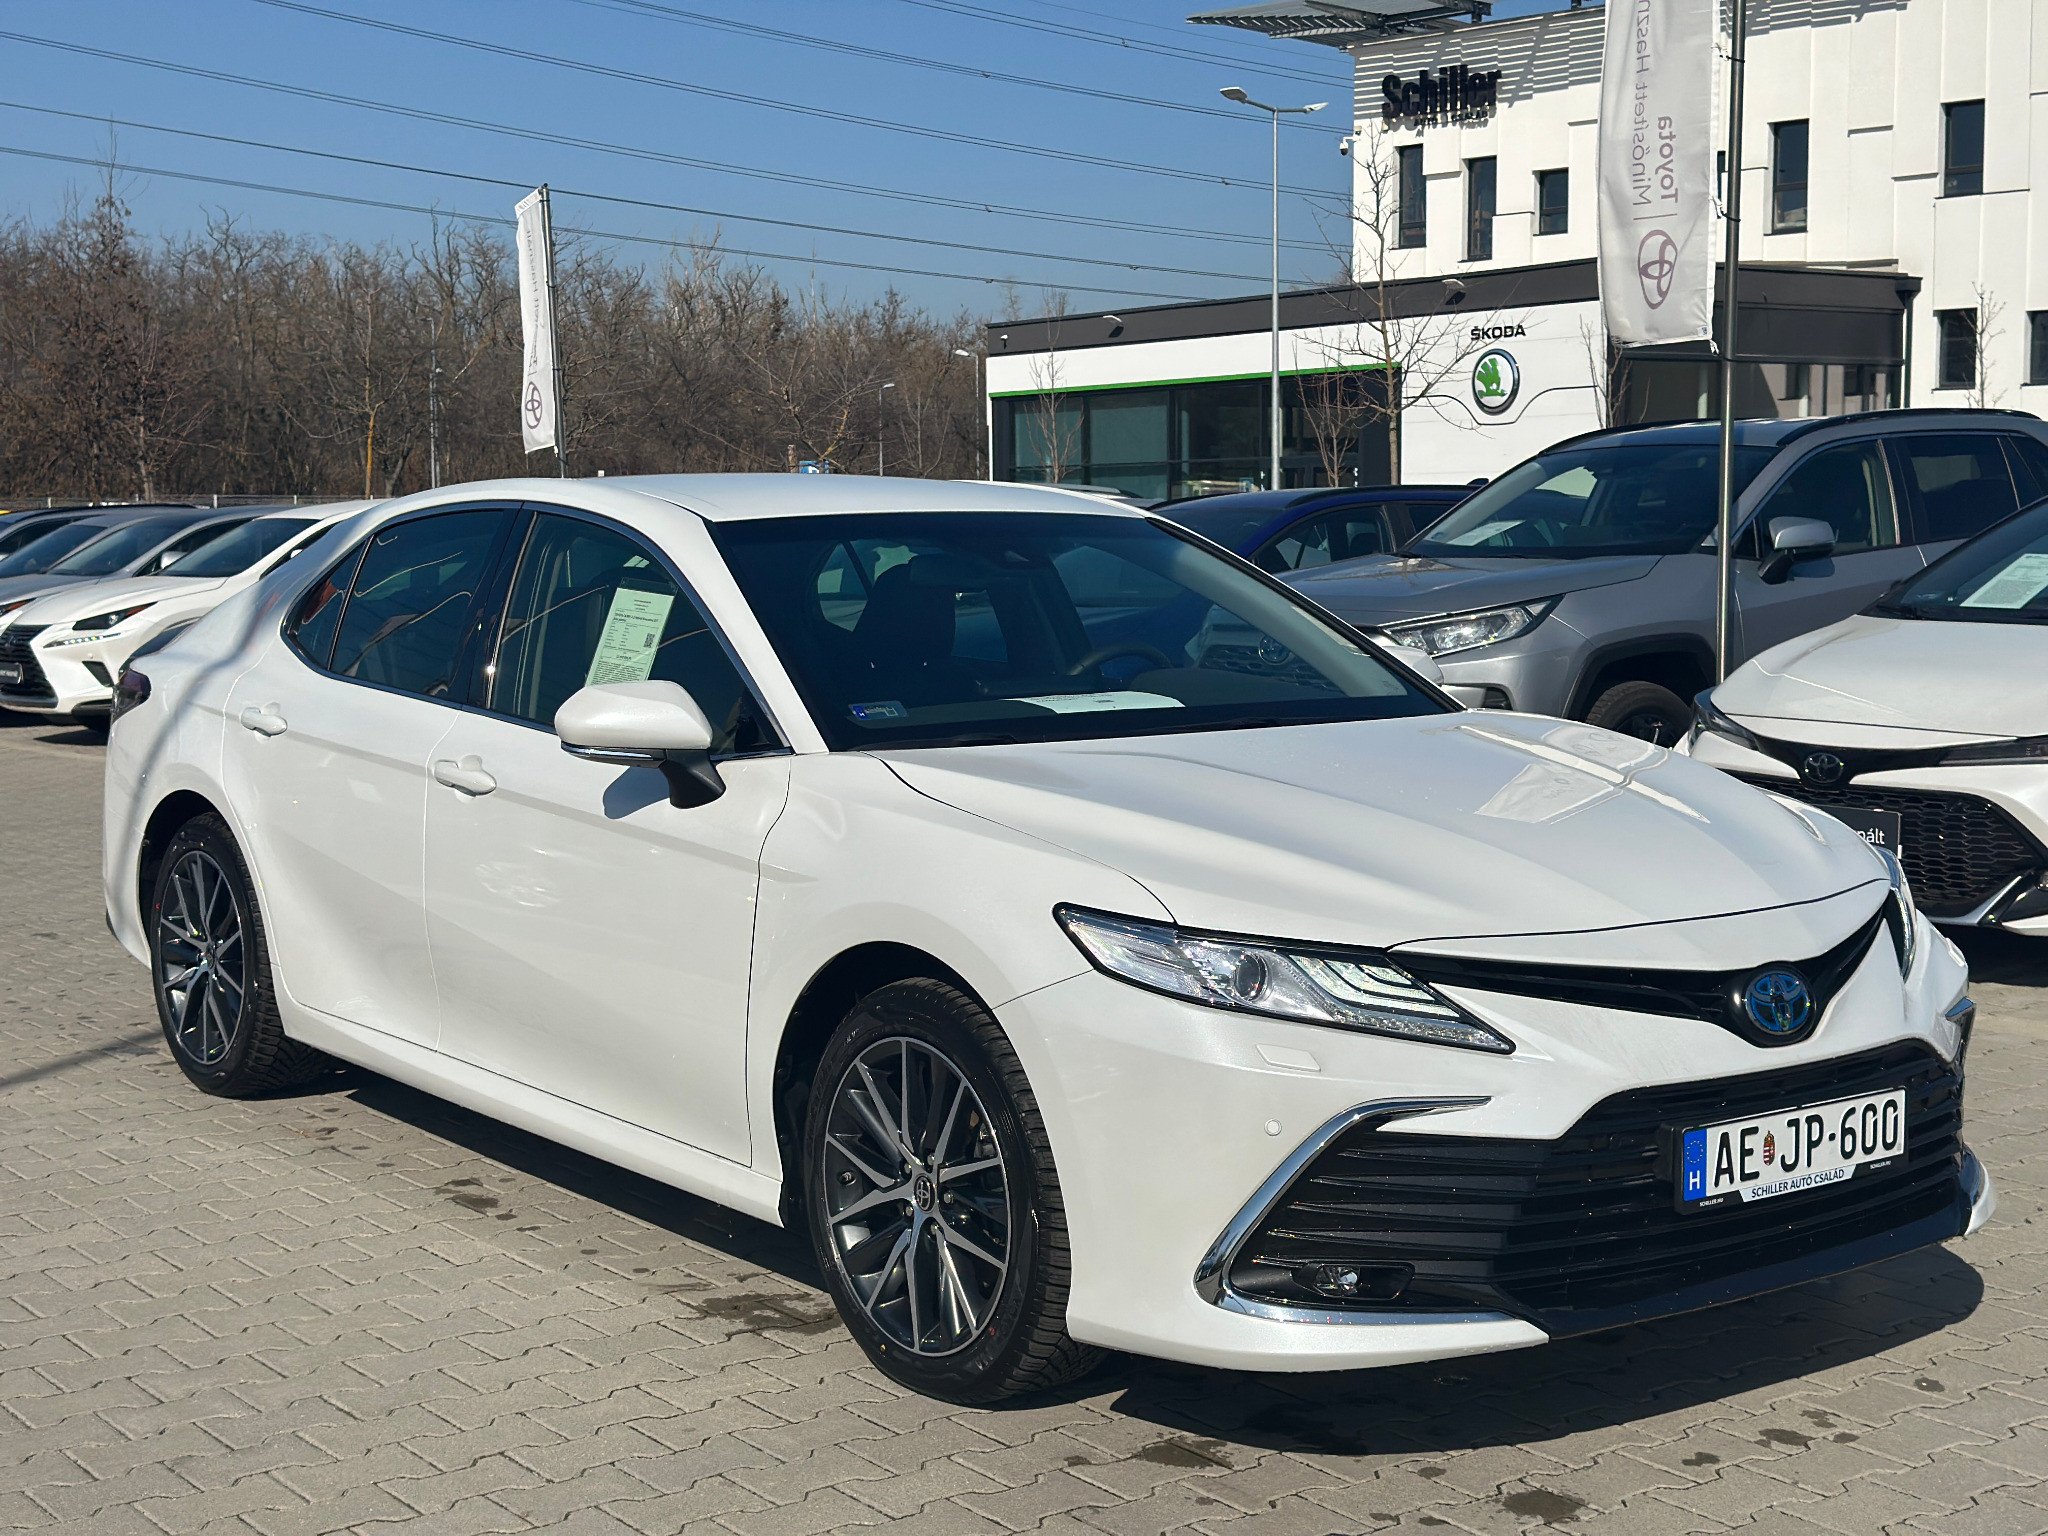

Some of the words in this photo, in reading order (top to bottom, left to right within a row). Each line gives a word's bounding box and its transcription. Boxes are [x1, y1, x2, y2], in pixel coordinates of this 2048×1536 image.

[1382, 64, 1502, 118] Schiller
[1470, 324, 1526, 341] ŠKODA
[1713, 1126, 1760, 1188] AE
[1780, 1098, 1899, 1173] JP-600
[1689, 1171, 1700, 1191] H
[1751, 1183, 1789, 1199] SCHILLER
[1789, 1173, 1813, 1190] AUTÓ
[1814, 1167, 1845, 1184] CSALÁD
